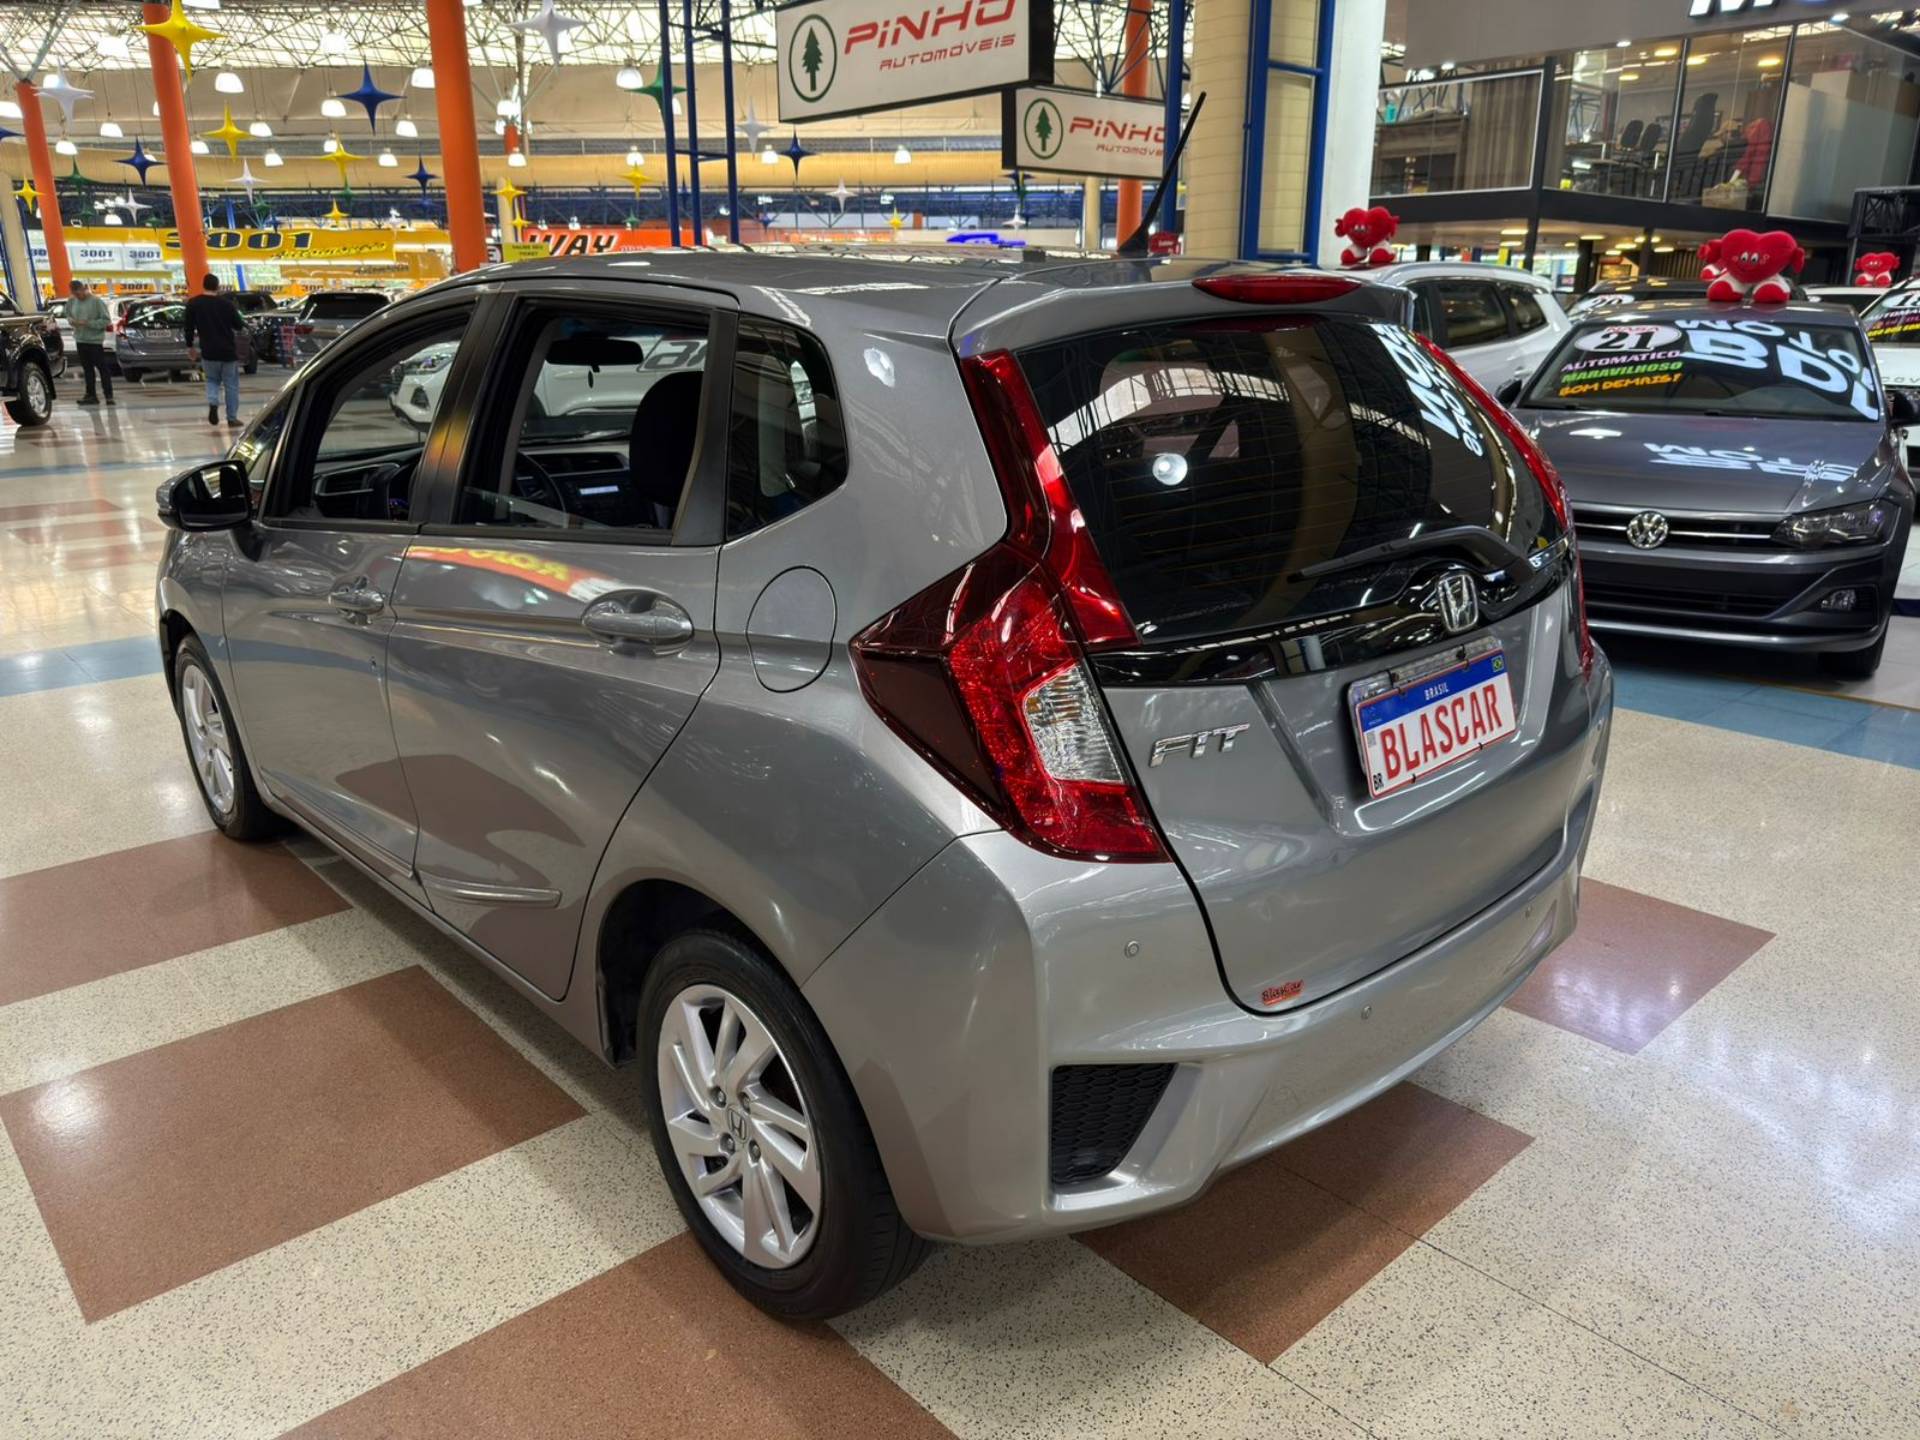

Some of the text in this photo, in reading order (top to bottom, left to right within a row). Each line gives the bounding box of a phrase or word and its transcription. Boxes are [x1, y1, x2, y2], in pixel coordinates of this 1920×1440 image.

[80, 249, 113, 258] 3001
[1595, 331, 1656, 350] 21
[1562, 361, 1683, 383] MARAVILHOSO
[1424, 682, 1449, 701] BRASIL
[1380, 683, 1502, 780] BLASCAR
[1150, 724, 1250, 767] FIT
